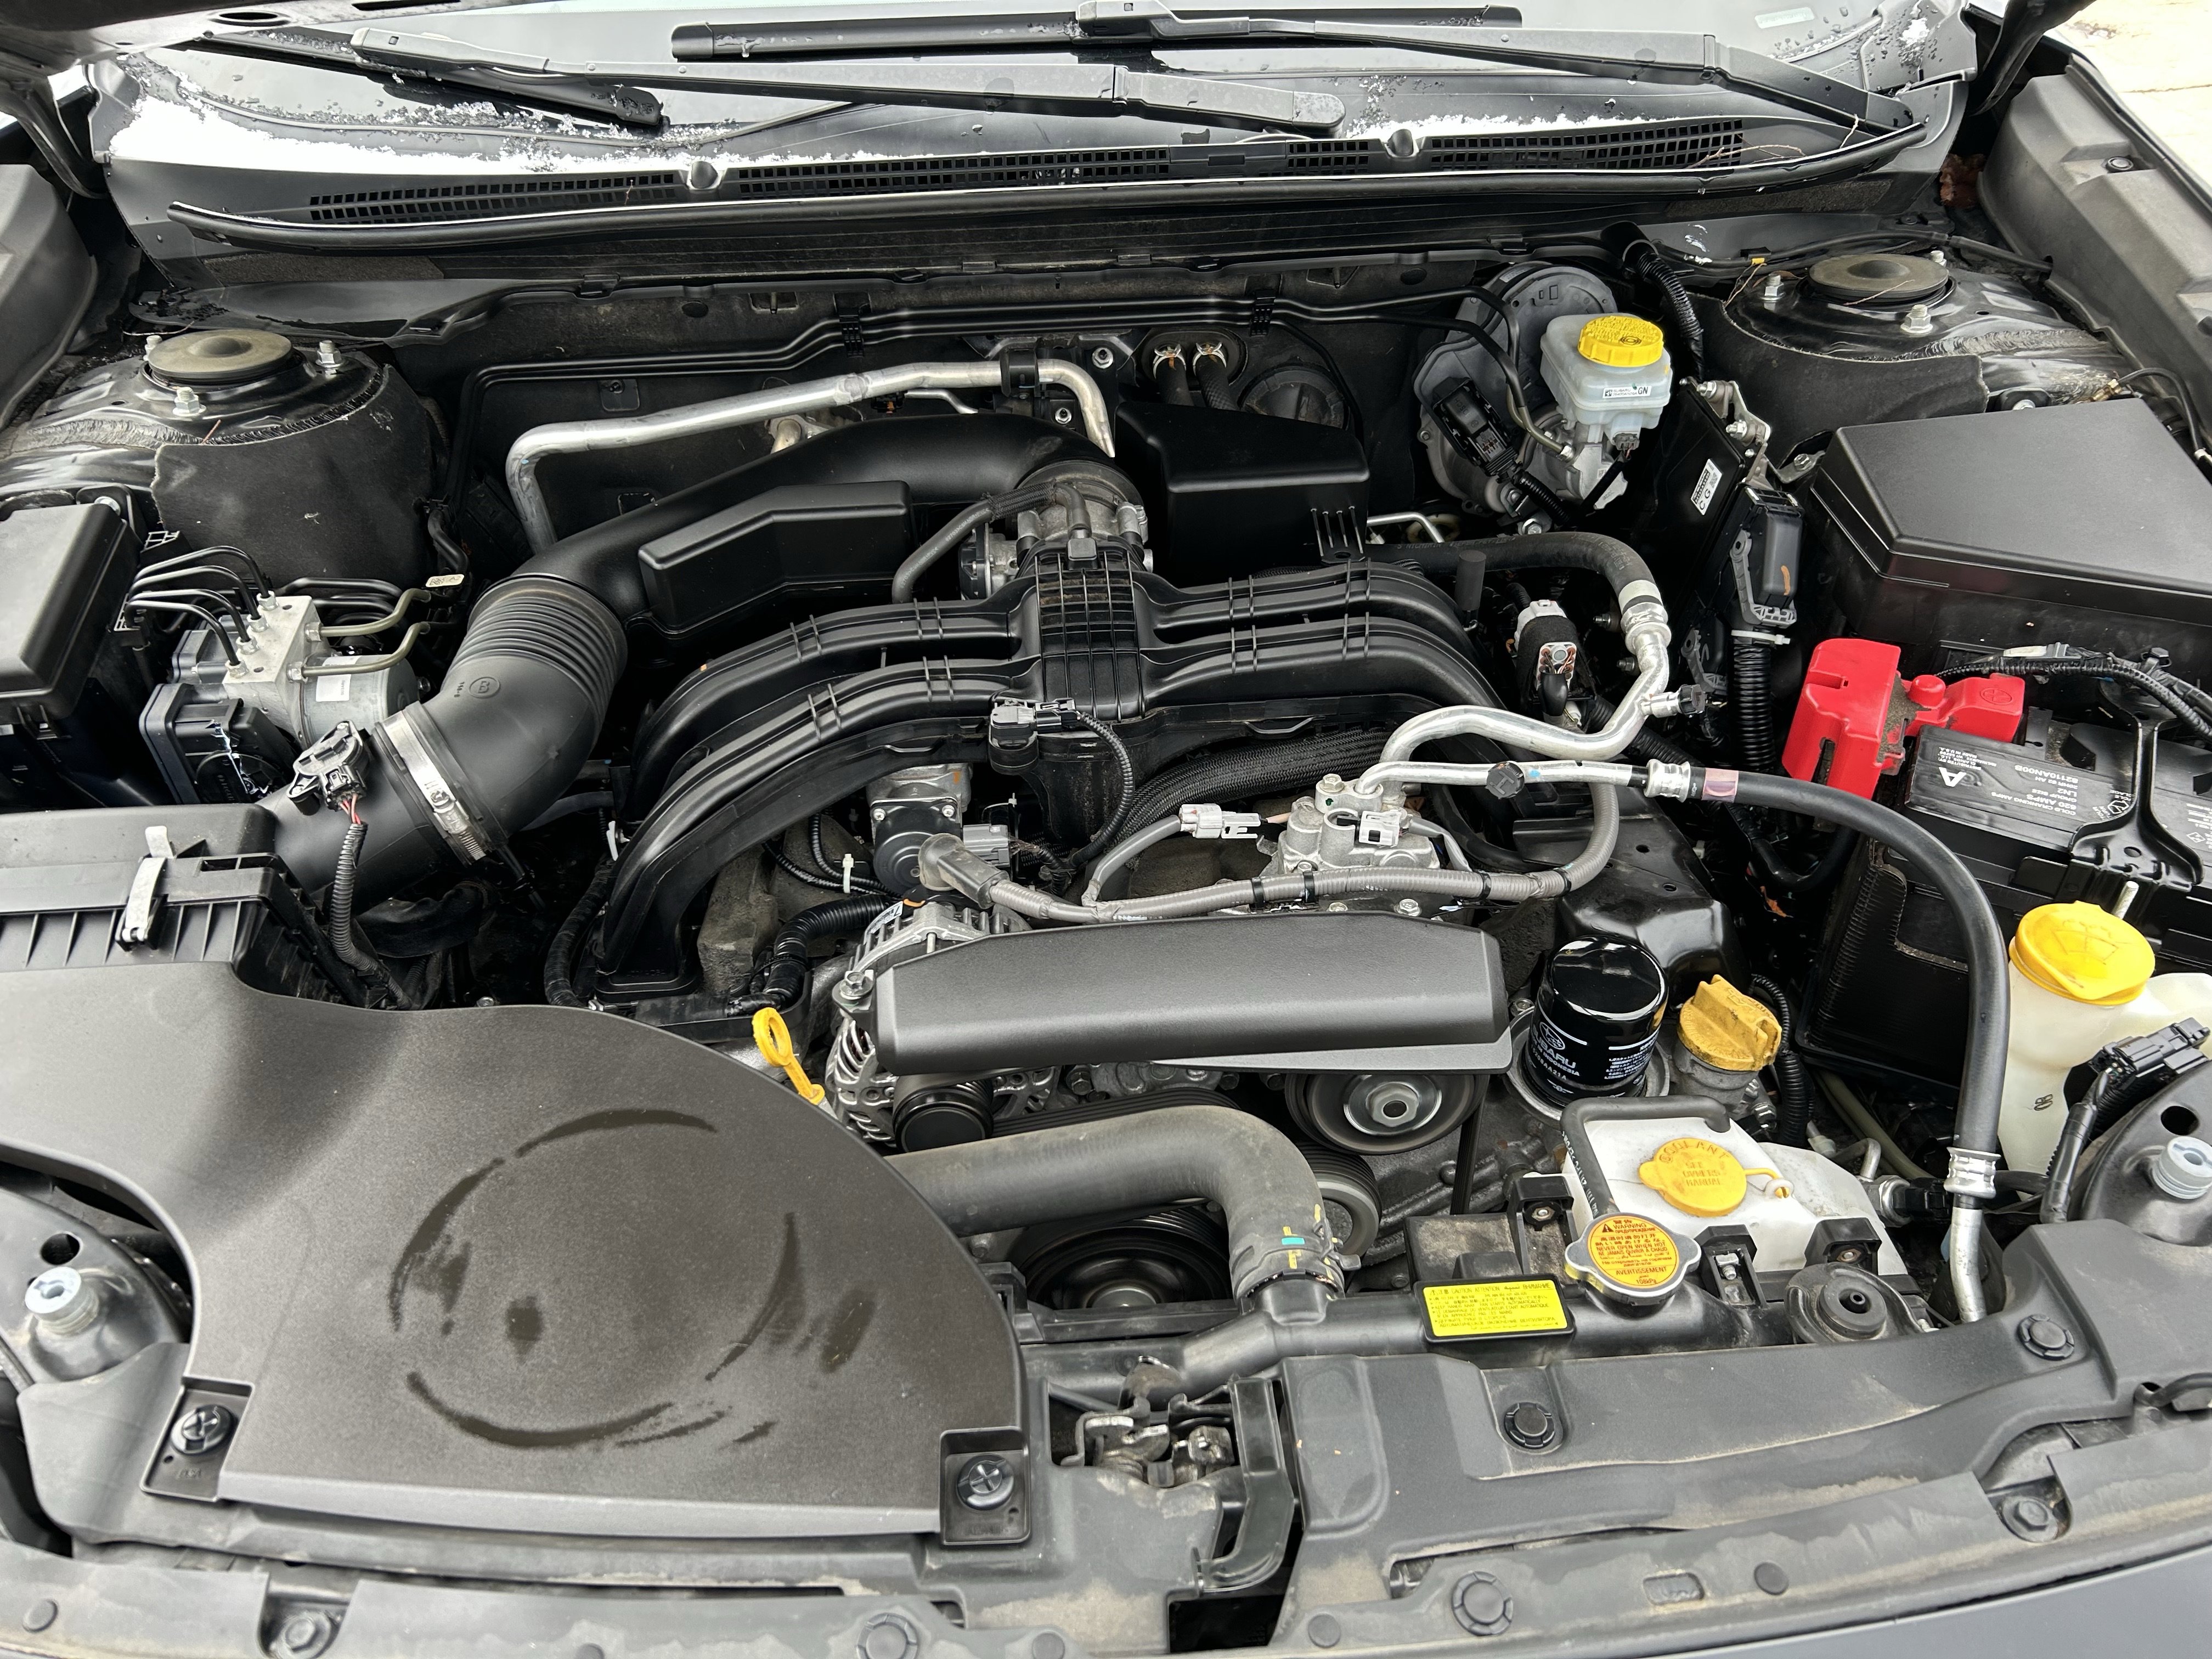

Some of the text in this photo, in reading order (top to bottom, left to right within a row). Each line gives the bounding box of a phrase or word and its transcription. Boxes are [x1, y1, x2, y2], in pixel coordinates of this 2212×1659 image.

[1489, 770, 1515, 795] H
[1938, 767, 1967, 787] A
[2026, 794, 2076, 810] 620 AMPS
[2050, 793, 2077, 803] GROUP
[2057, 788, 2077, 797] LN2
[1991, 792, 2076, 816] COLD CRANKING AMPS
[1532, 1024, 1576, 1069] SUBARU
[1543, 1053, 1580, 1076] INDONESIA
[1659, 1140, 1730, 1164] COOLANT
[1616, 1266, 1667, 1276] AVERTISSEMENT
